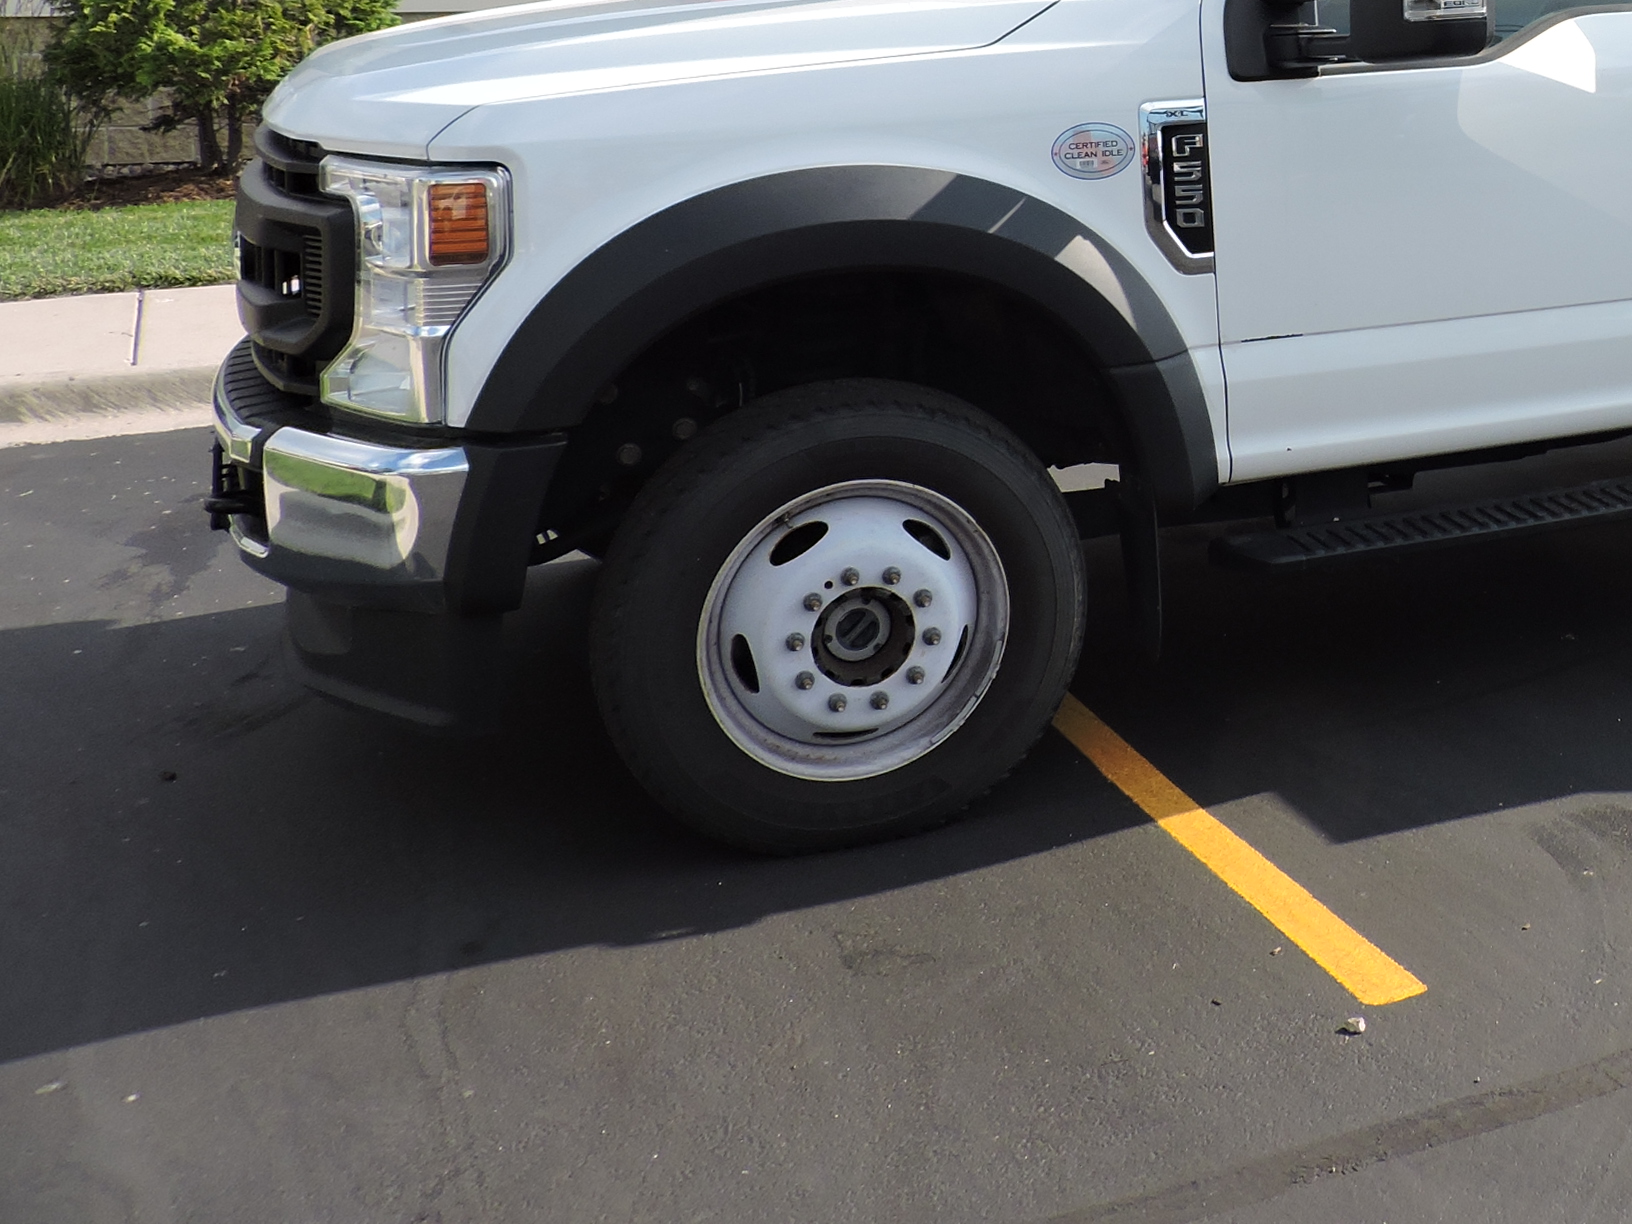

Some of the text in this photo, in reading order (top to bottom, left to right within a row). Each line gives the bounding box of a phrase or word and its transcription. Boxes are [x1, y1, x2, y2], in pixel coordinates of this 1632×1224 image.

[1068, 140, 1119, 151] CERTIFIED
[1064, 148, 1124, 160] CLEAN IDLE
[1171, 133, 1206, 229] F550
